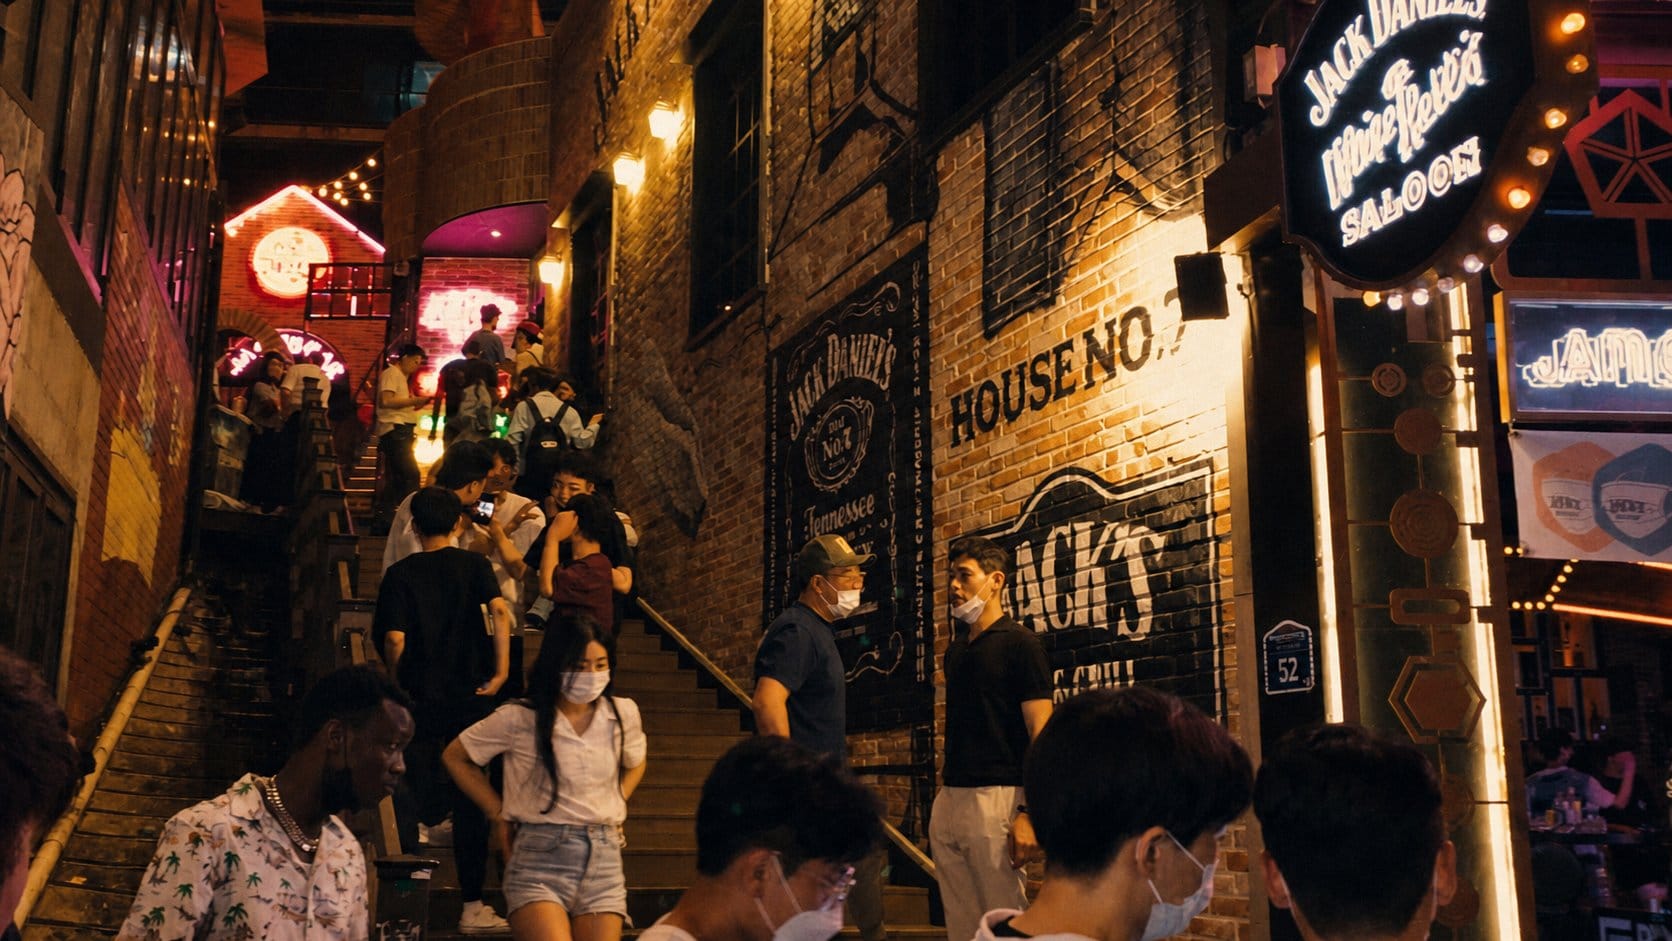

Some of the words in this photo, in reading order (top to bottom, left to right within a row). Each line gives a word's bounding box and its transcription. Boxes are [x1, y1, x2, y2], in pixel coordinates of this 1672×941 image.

[1304, 14, 1375, 127] JACK
[788, 356, 826, 441] JACK
[827, 328, 897, 391] DANIEL'S
[951, 338, 1077, 448] HOUSE
[803, 493, 876, 541] Tennessee
[1002, 521, 1168, 641] ACK'S
[1278, 657, 1299, 683] 52
